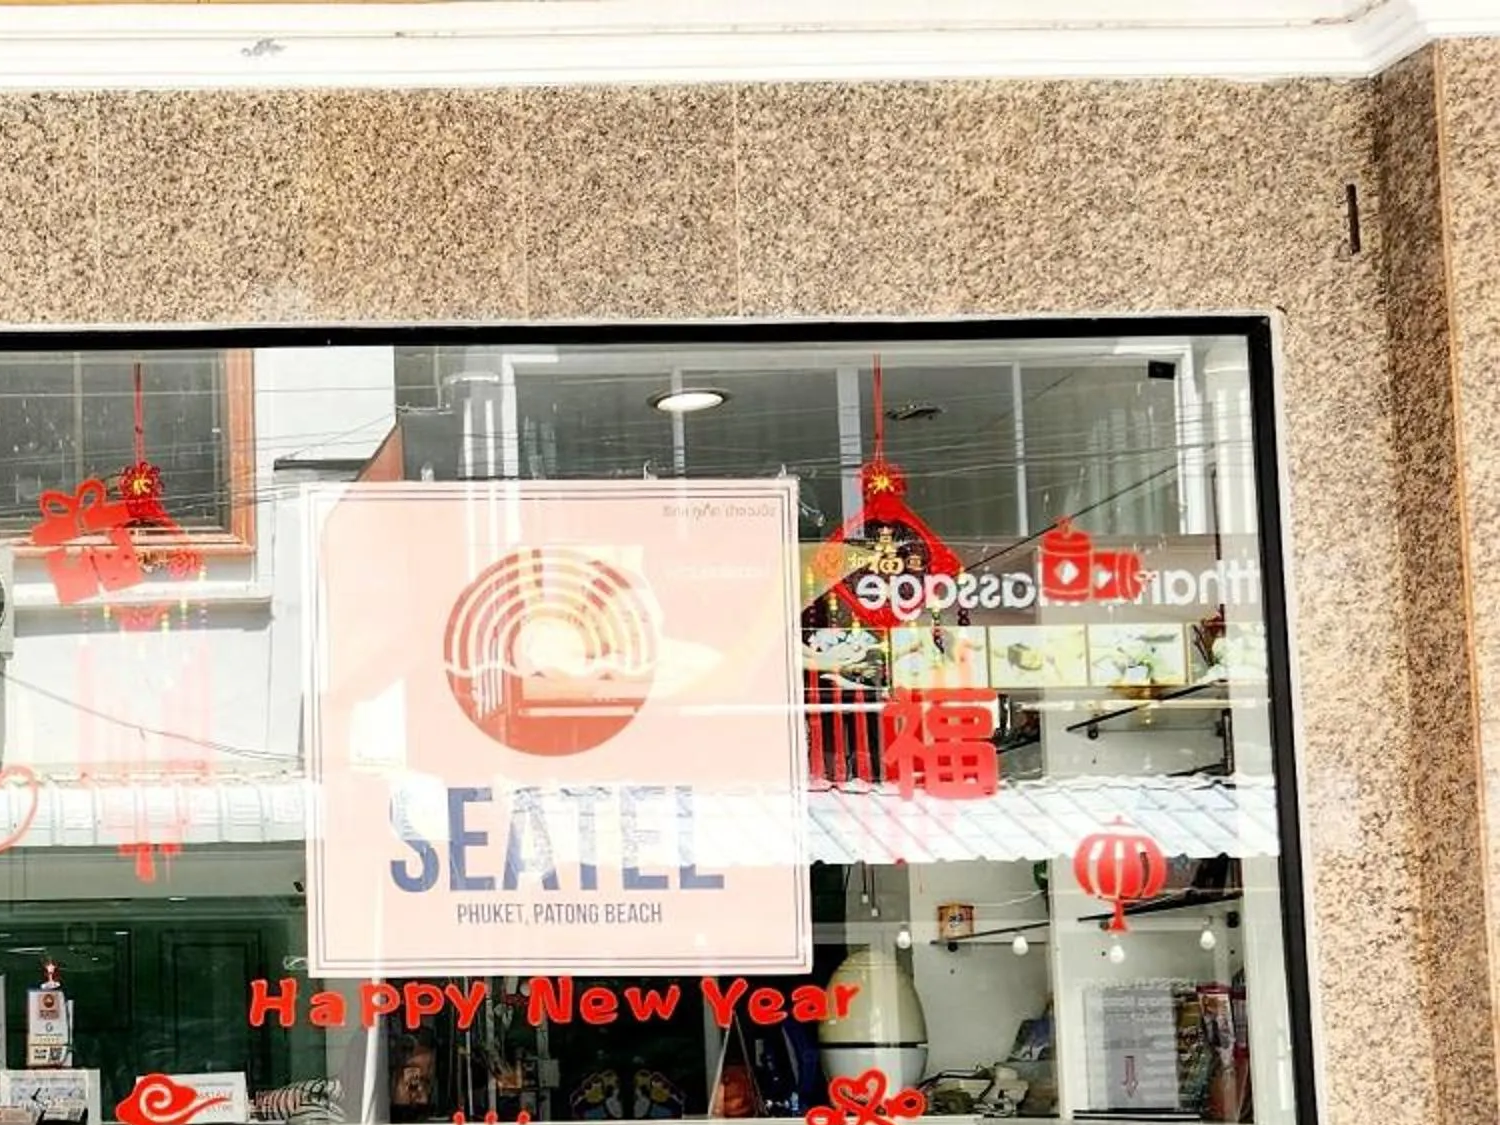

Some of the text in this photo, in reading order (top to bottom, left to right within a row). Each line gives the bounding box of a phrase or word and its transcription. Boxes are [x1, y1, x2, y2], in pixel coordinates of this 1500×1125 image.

[388, 784, 726, 893] SEATEL
[456, 902, 663, 927] PHUKET, PATONG BEACH
[249, 976, 860, 1028] Happy New Year
